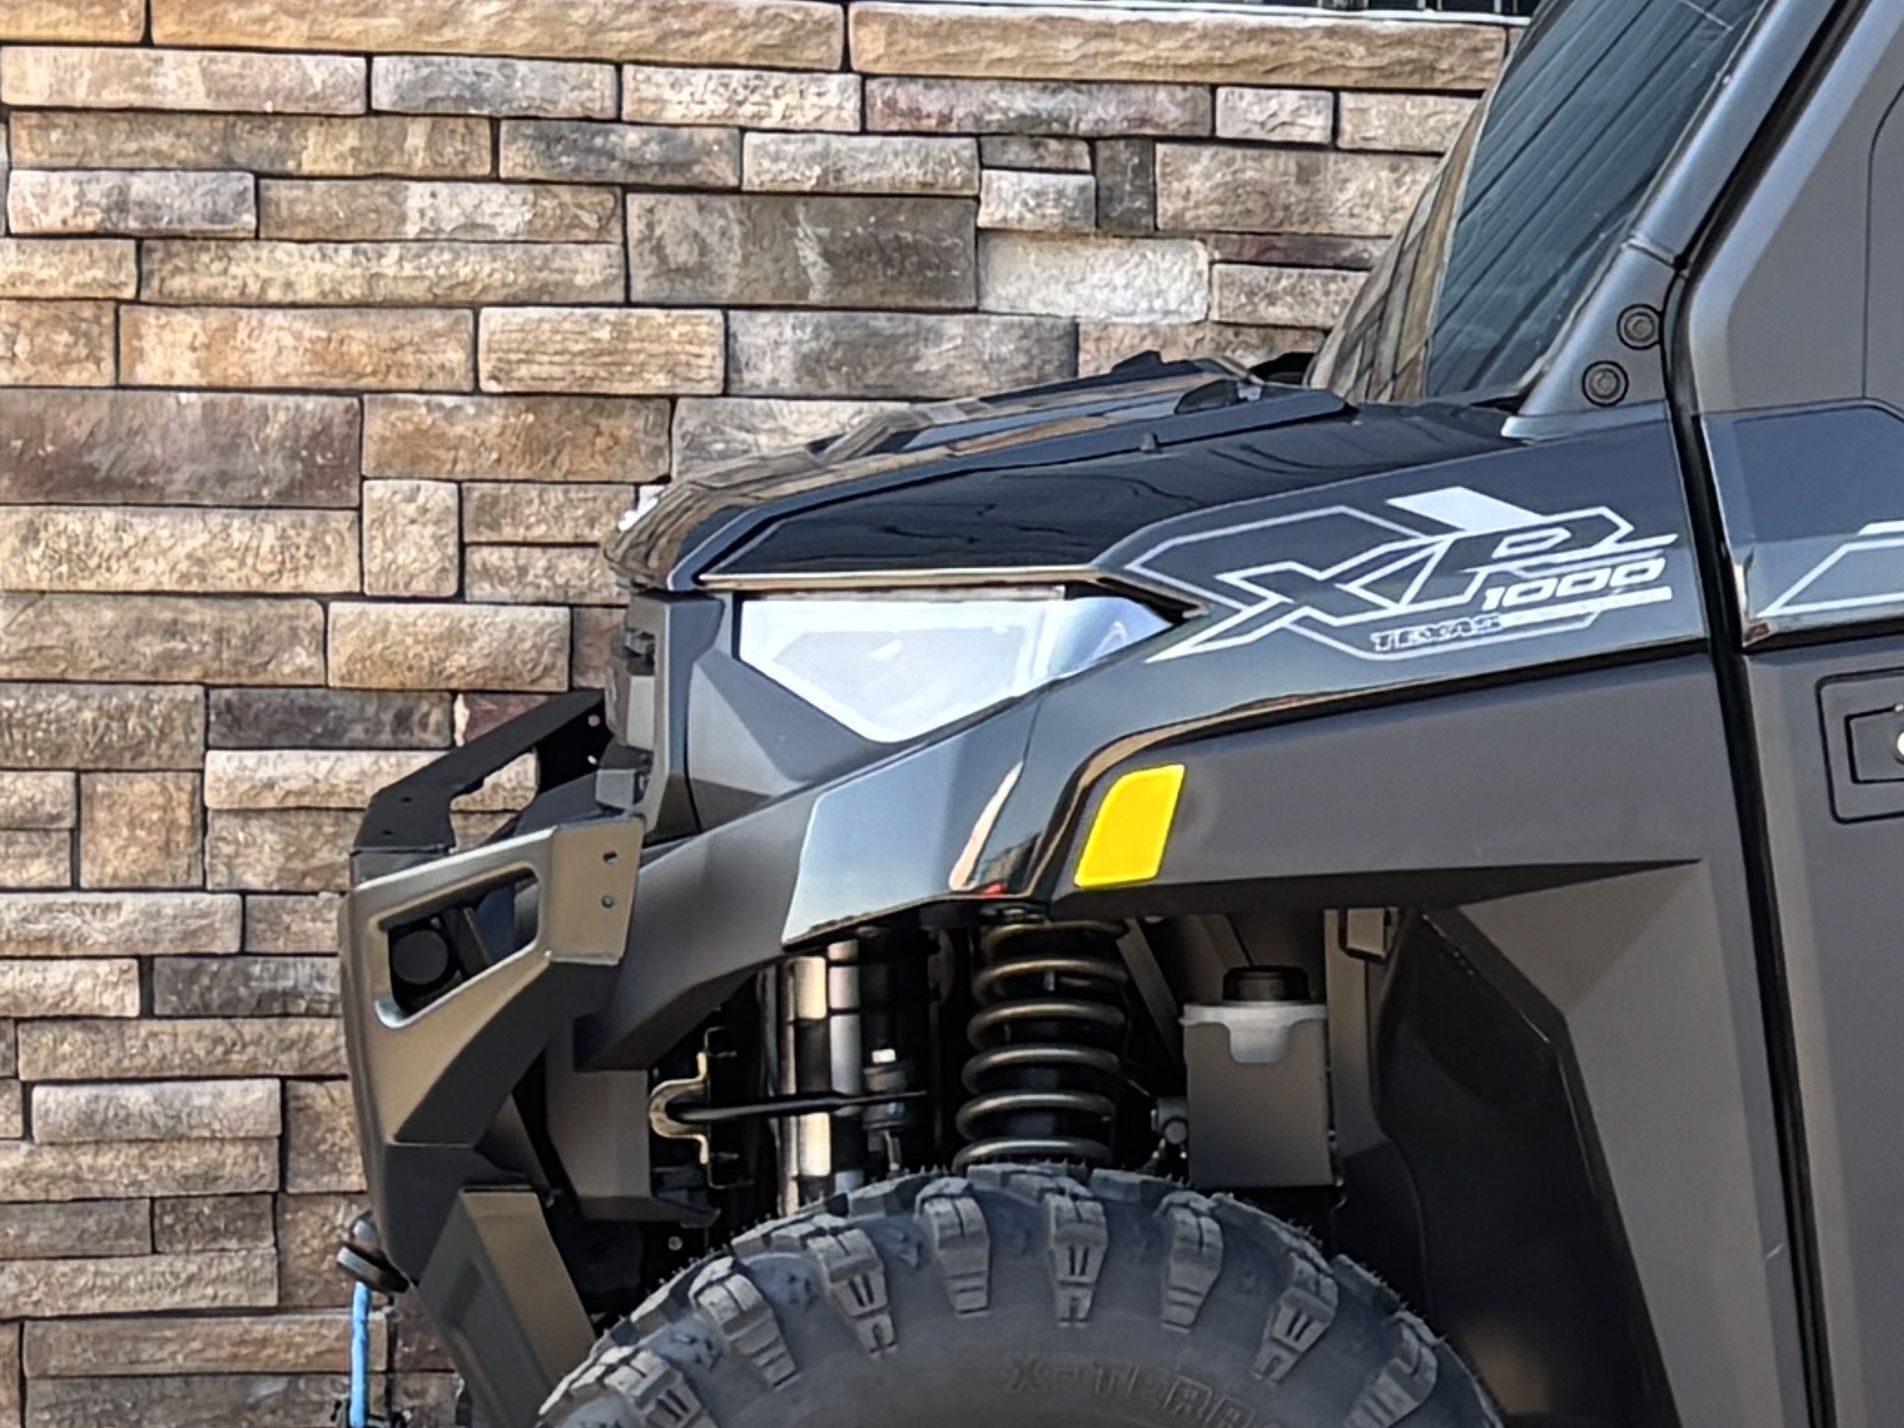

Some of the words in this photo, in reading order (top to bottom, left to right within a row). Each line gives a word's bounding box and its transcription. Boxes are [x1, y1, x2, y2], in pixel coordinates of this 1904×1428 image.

[1128, 502, 1677, 663] XP
[1481, 557, 1666, 611] 1000
[1370, 612, 1502, 652] TEXAS
